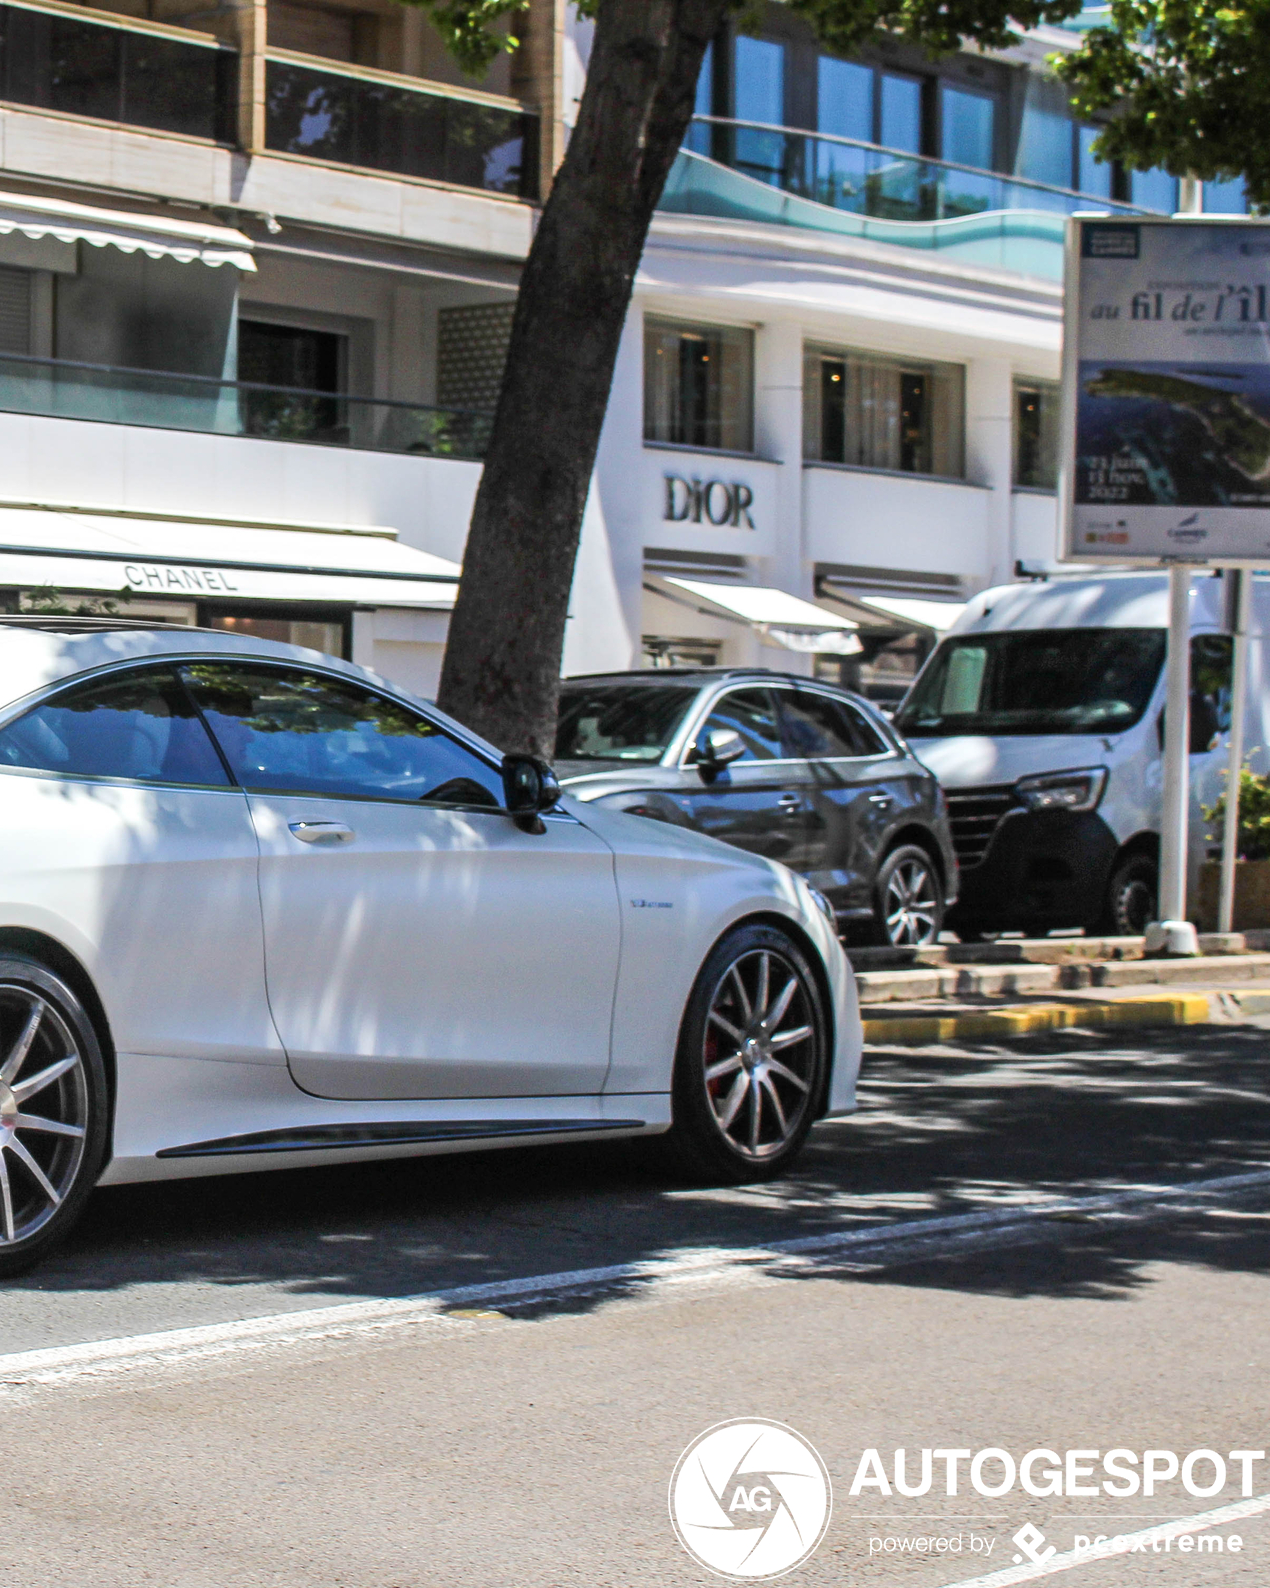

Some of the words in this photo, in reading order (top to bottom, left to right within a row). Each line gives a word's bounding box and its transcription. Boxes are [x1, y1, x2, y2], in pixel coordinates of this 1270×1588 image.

[1090, 303, 1120, 320] au
[1132, 290, 1163, 321] fil
[1171, 292, 1206, 321] de
[1214, 283, 1270, 322] l'îl
[124, 565, 239, 592] CHANEL
